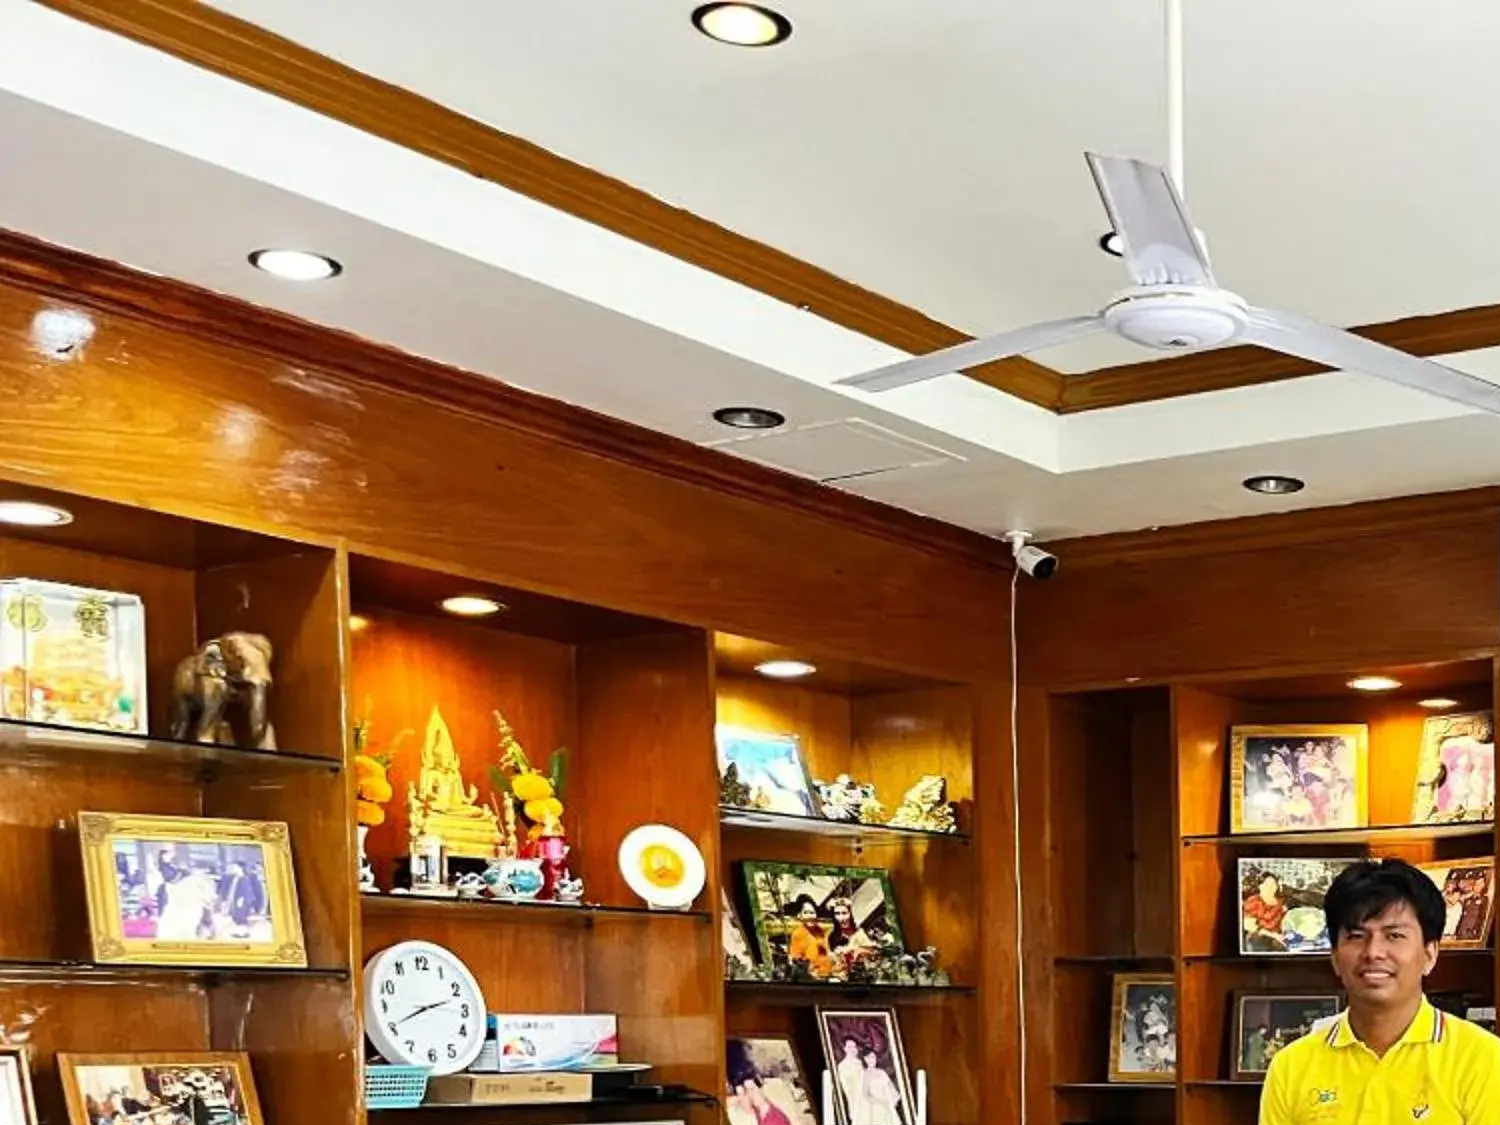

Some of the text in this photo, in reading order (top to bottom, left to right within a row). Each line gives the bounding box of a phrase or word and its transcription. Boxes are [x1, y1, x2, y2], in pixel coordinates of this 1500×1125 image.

[415, 956, 430, 971] 12
[451, 981, 461, 997] 2
[461, 1003, 470, 1019] 3
[458, 1023, 468, 1037] 4
[427, 1048, 438, 1062] 6
[446, 1043, 457, 1059] 5
